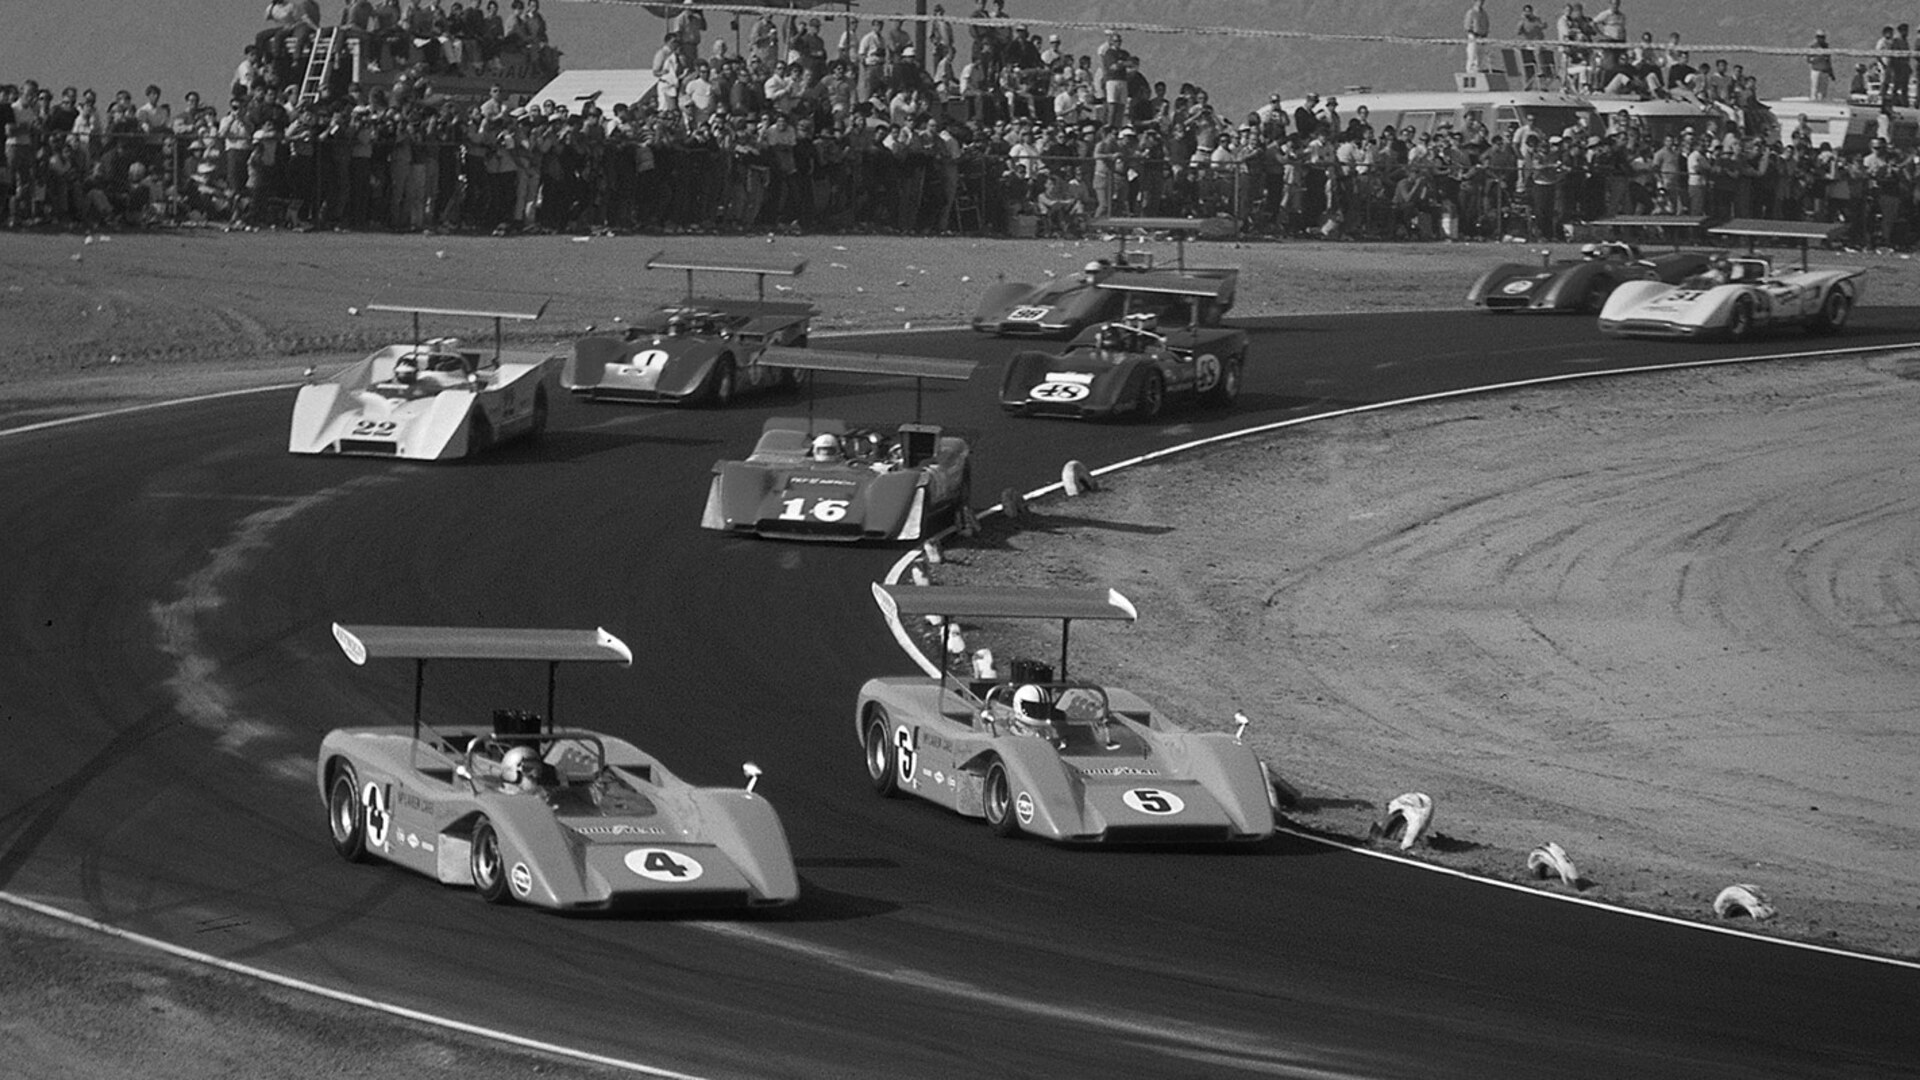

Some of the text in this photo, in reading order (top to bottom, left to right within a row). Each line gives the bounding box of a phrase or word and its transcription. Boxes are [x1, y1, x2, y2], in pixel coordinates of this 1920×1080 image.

[646, 352, 656, 366] 1
[1037, 384, 1082, 399] 48
[352, 420, 397, 436] 22
[778, 497, 851, 522] 16
[898, 730, 914, 779] 5
[368, 785, 384, 840] 4
[1133, 790, 1172, 812] 5
[643, 851, 689, 877] 4
